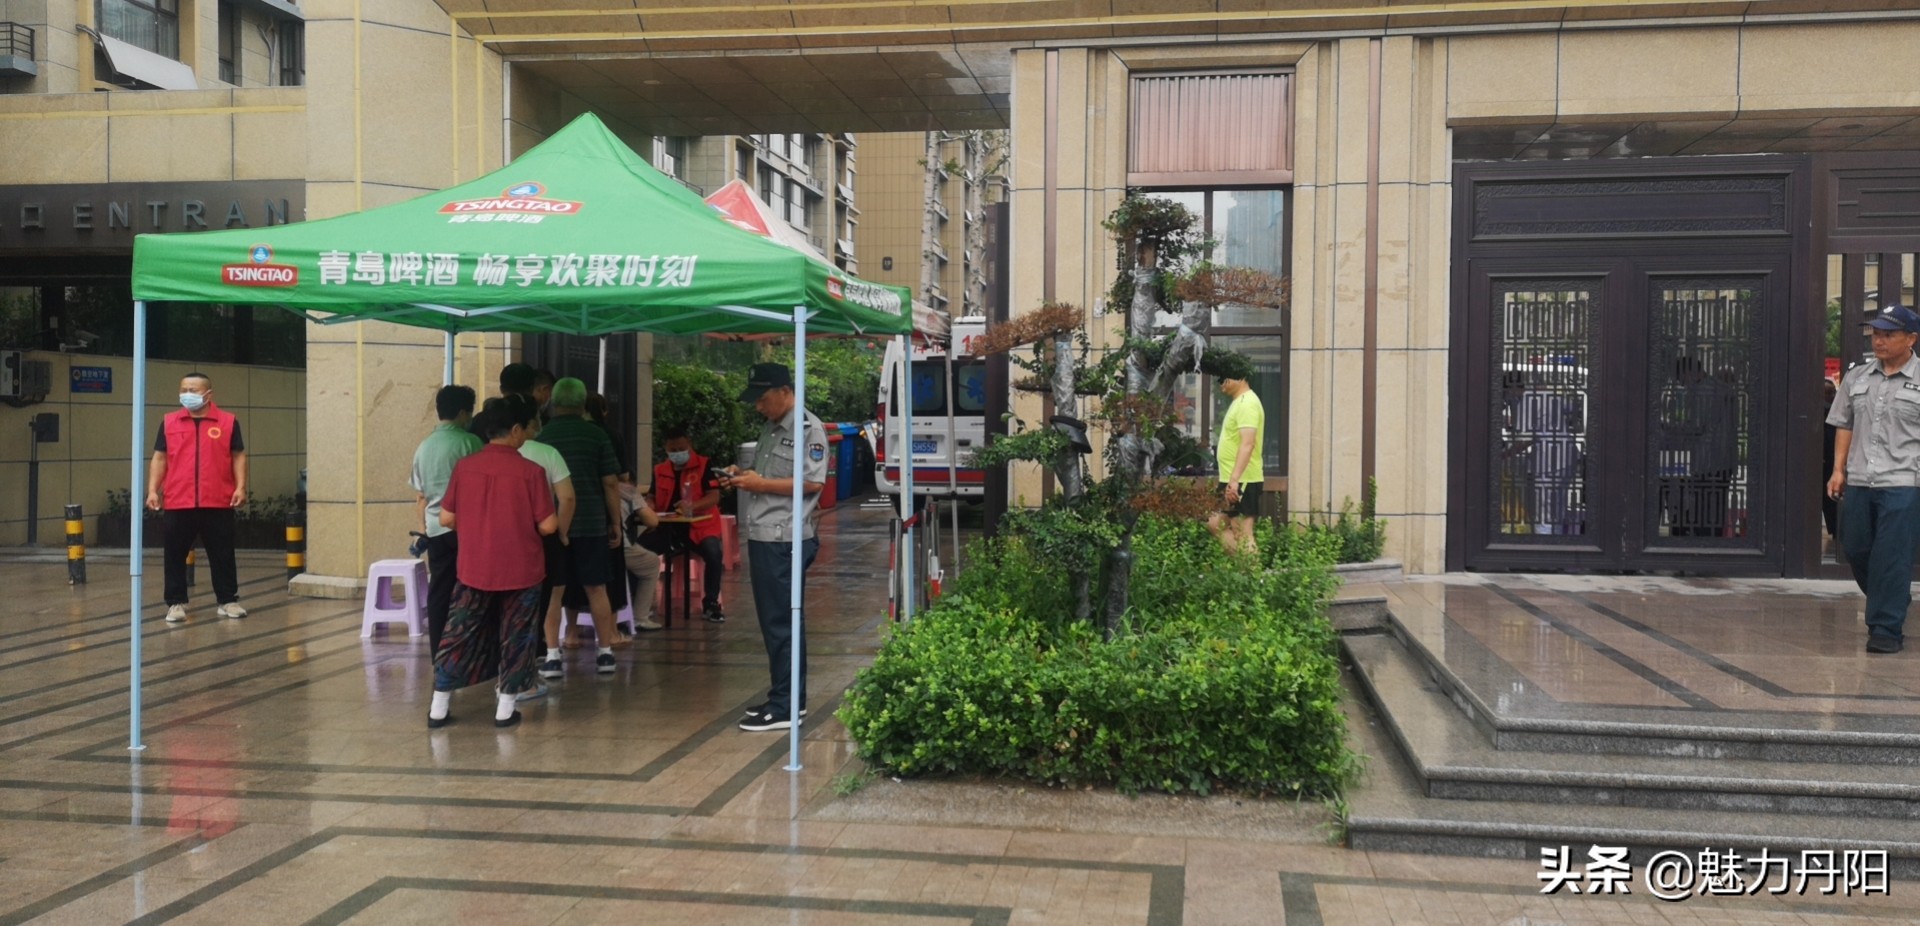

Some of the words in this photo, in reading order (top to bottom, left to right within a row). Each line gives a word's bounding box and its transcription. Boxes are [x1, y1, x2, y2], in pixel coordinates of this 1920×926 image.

[454, 199, 572, 212] TSINGTAO
[448, 213, 546, 224] 青岛啤酒
[226, 267, 294, 282] TSINGTAO
[317, 250, 459, 286] 青岛啤酒
[473, 252, 698, 288] 畅享欢聚时刻
